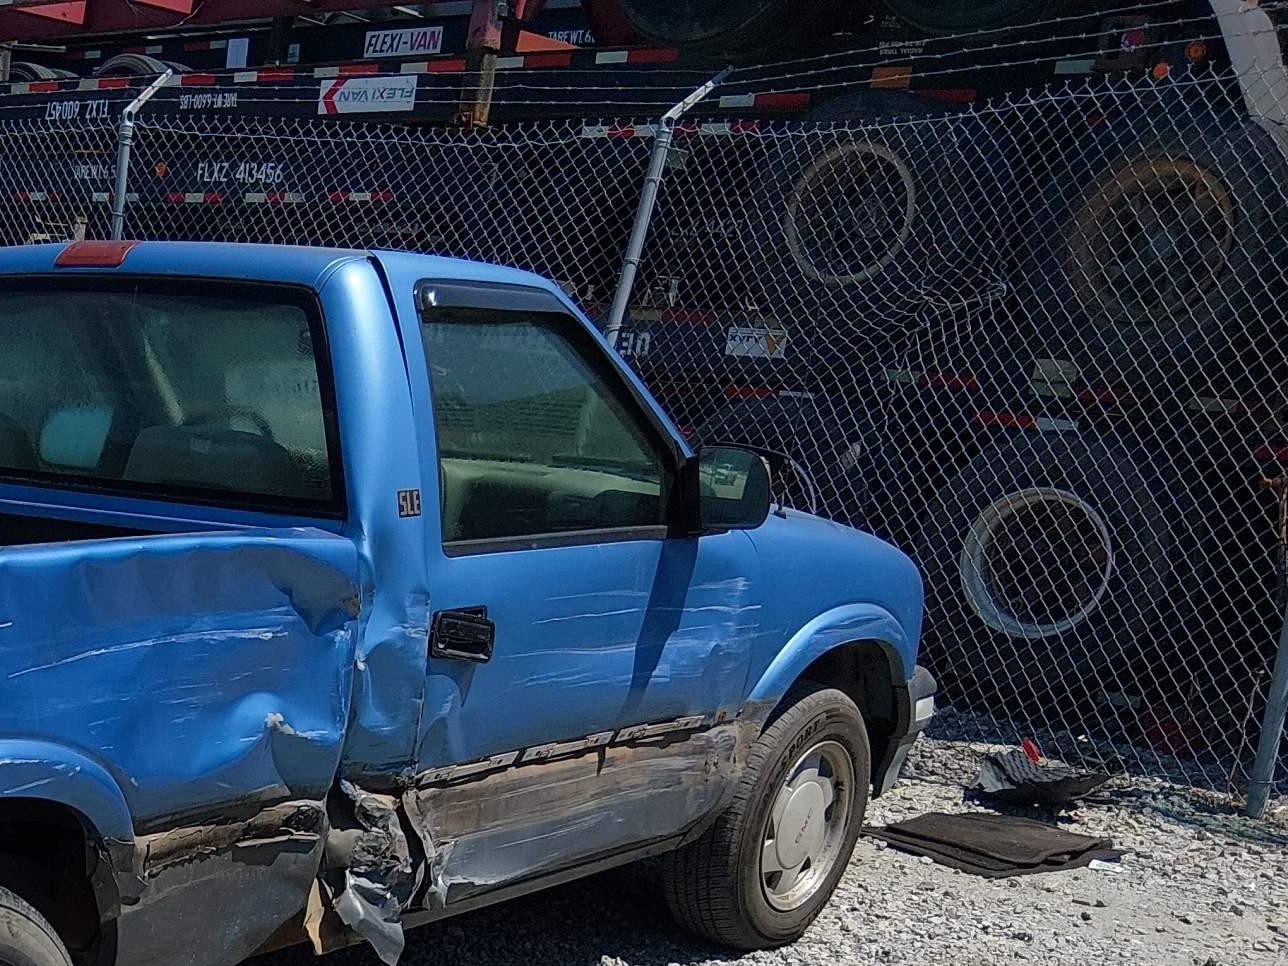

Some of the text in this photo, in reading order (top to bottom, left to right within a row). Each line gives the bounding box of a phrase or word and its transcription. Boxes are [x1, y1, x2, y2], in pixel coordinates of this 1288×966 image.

[366, 30, 441, 53] FLEXI-VAN
[85, 99, 109, 119] FLXZ
[196, 162, 228, 182] FLXZ
[399, 491, 420, 516] SLE
[781, 719, 821, 767] SPORT
